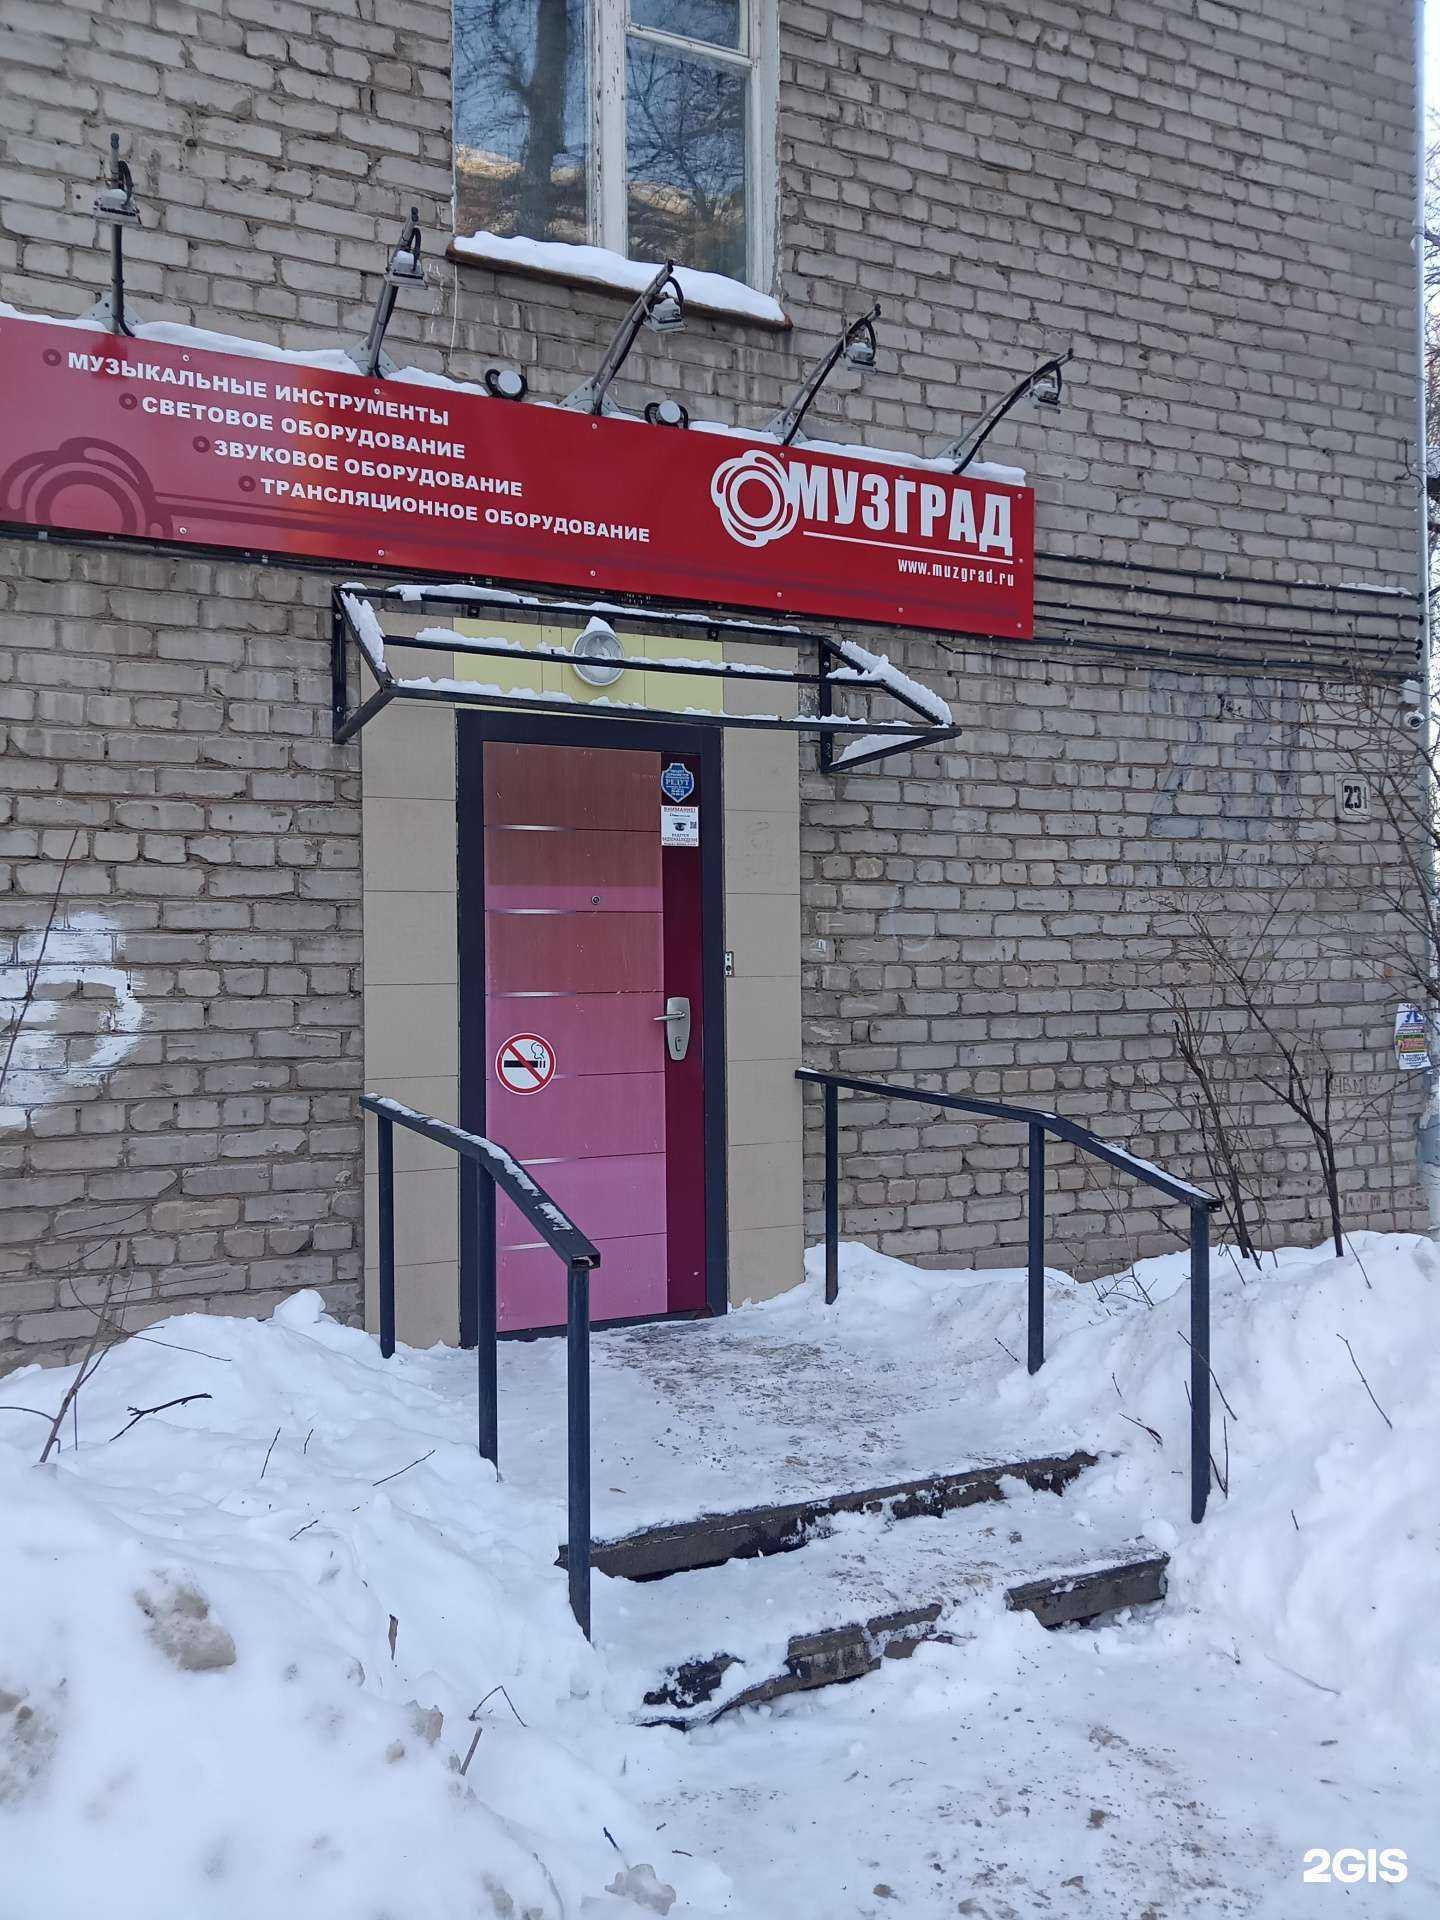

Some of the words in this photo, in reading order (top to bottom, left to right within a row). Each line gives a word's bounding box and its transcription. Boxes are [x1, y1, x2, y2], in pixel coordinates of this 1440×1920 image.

[67, 352, 268, 398] МУЗЫКАЛЬНЫЕ
[275, 385, 449, 426] ИНСТРУМЕНТЫ
[142, 396, 274, 431] СВЕТОВОЕ
[281, 417, 466, 459] ОБОРУДОВАНИЕ
[214, 439, 339, 471] ЗВУКОВОЕ
[344, 458, 523, 497] ОБОРУДОВАНИЕ
[260, 477, 478, 521] ТРАНСЛЯЦИОННОЕ
[485, 508, 650, 543] ОБОРУДОВАНИЕ
[788, 461, 1013, 557] МУЗГРАД
[897, 558, 1015, 587] www.muzgrad.ru
[1343, 785, 1362, 809] 23
